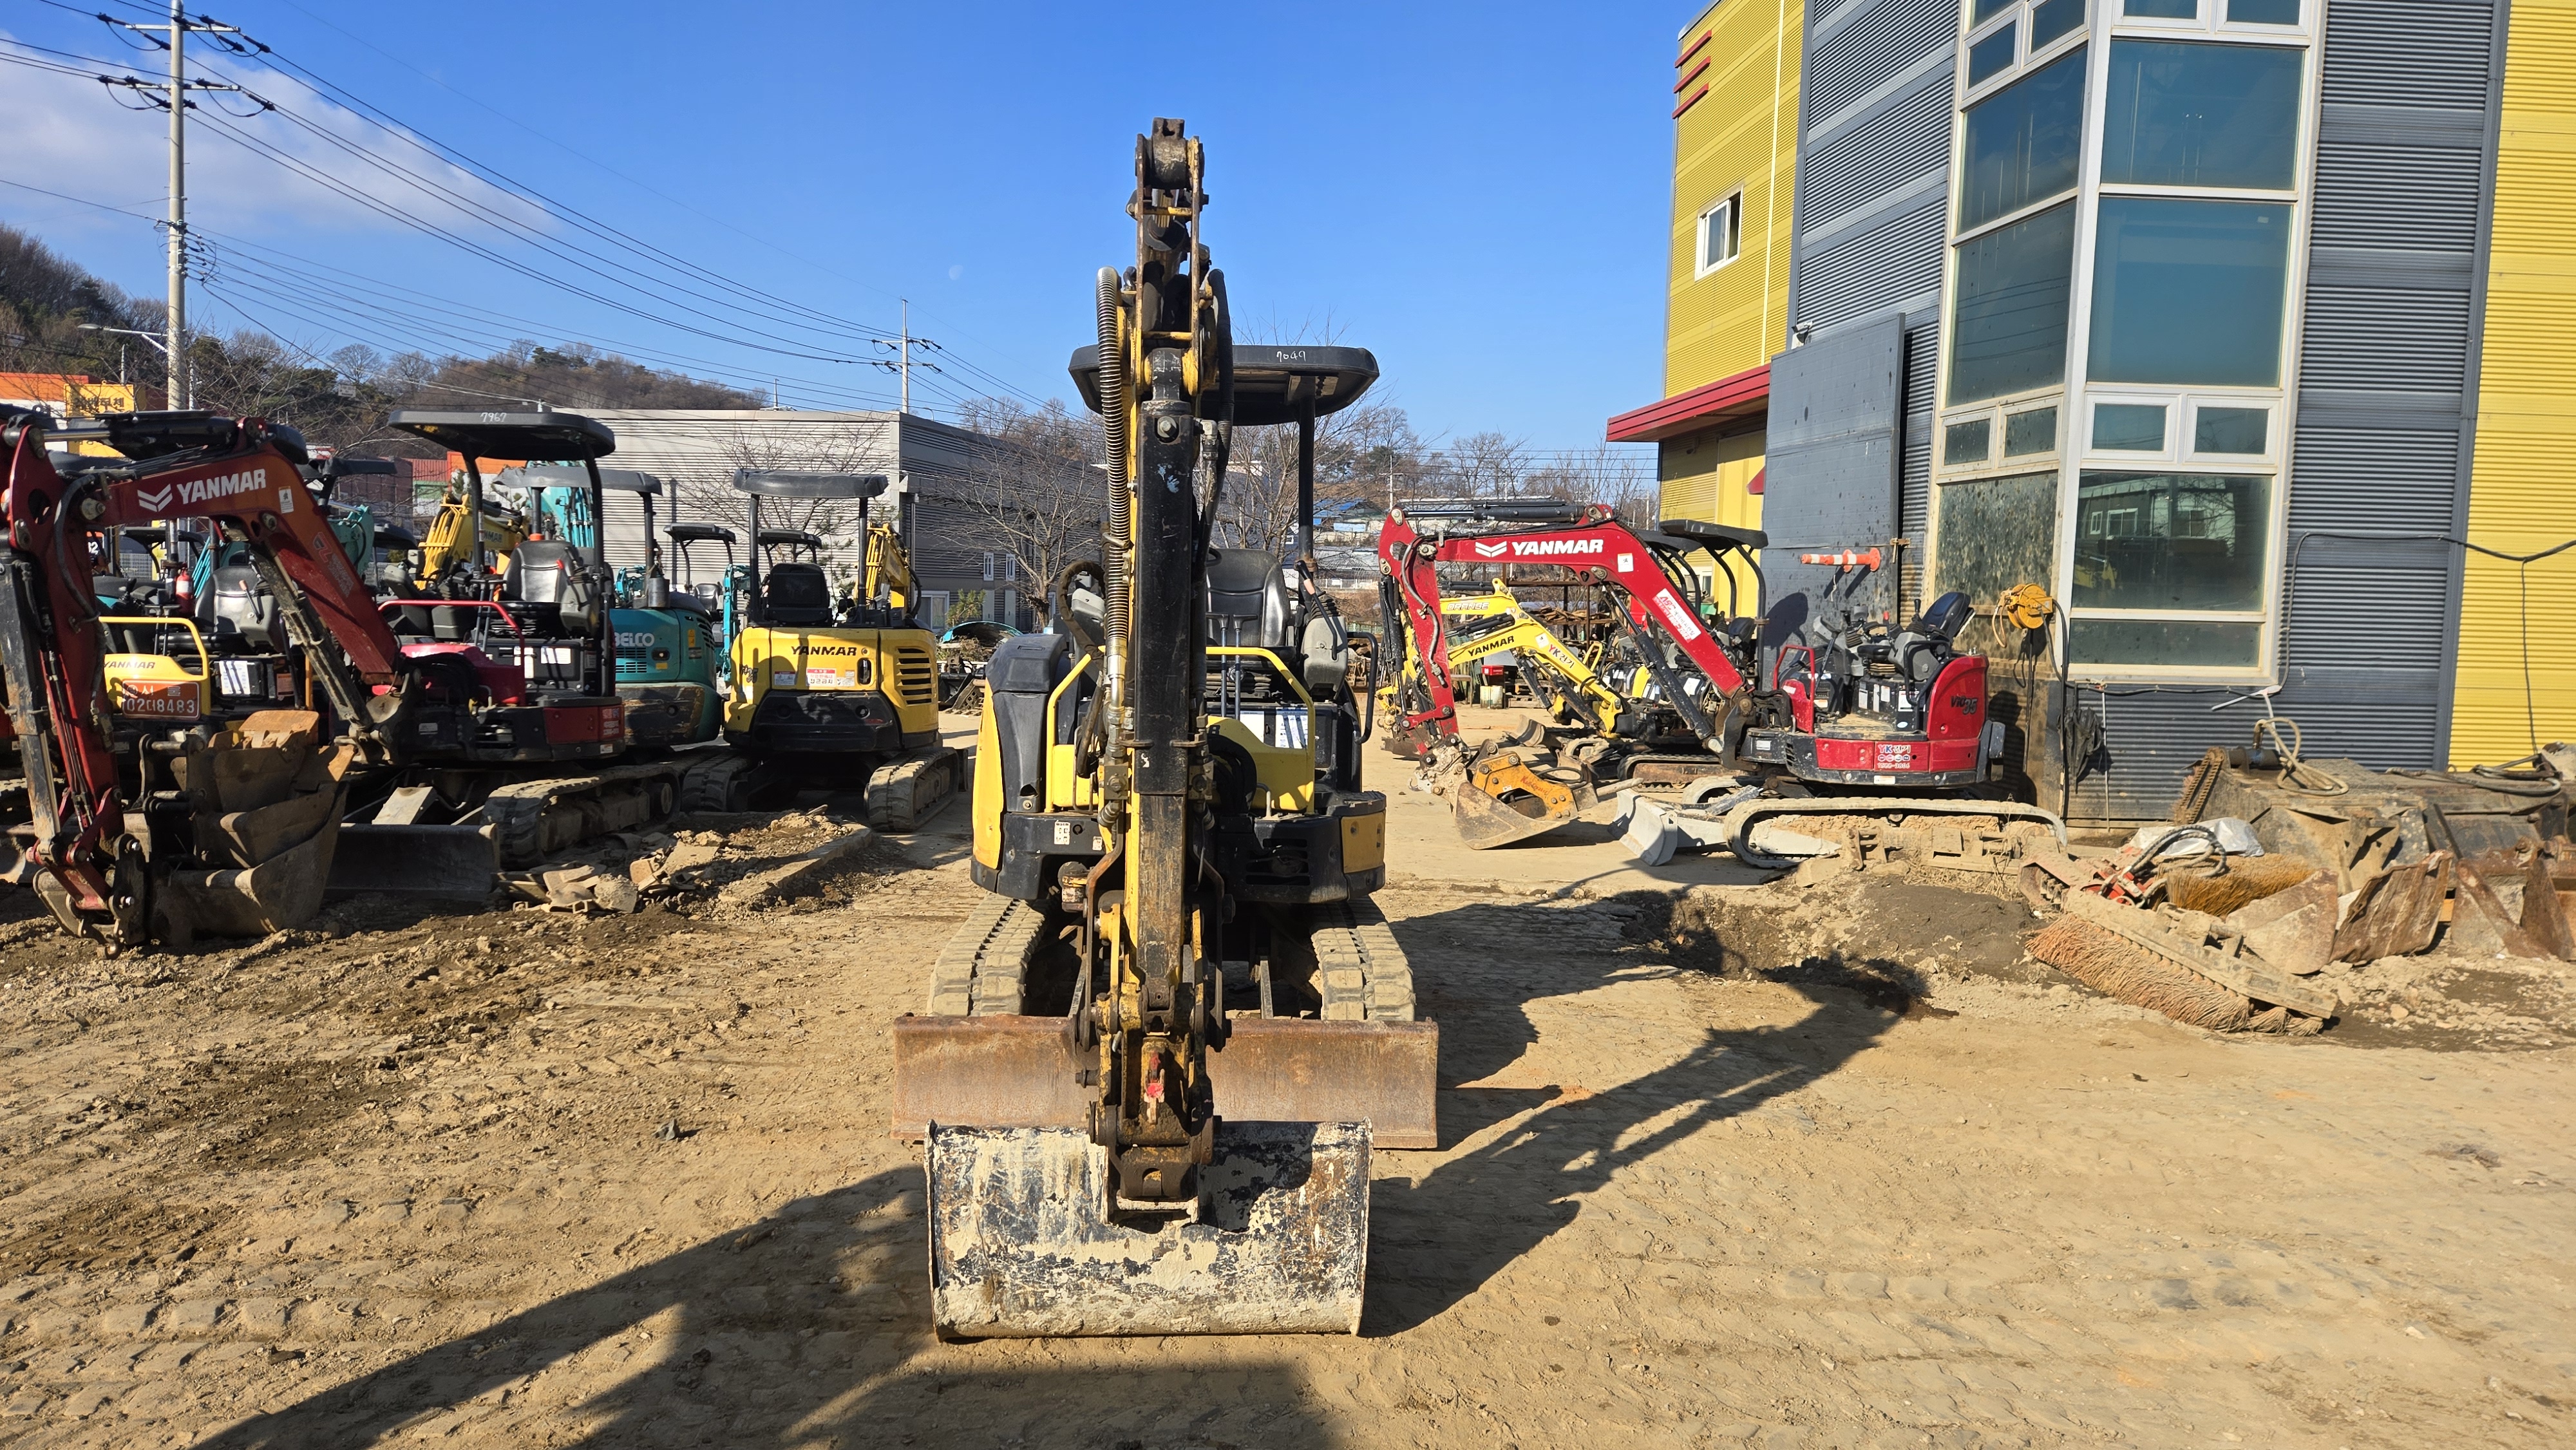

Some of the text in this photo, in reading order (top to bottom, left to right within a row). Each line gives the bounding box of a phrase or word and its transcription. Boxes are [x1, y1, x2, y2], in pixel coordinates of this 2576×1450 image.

[480, 412, 507, 423] 7967
[176, 468, 267, 505] YANMAR
[1511, 539, 1604, 556] YANMAR
[1446, 602, 1490, 611] ORANGE
[614, 632, 654, 647] BELCO
[1468, 636, 1514, 657] YANMAR
[791, 646, 857, 656] YANMAR
